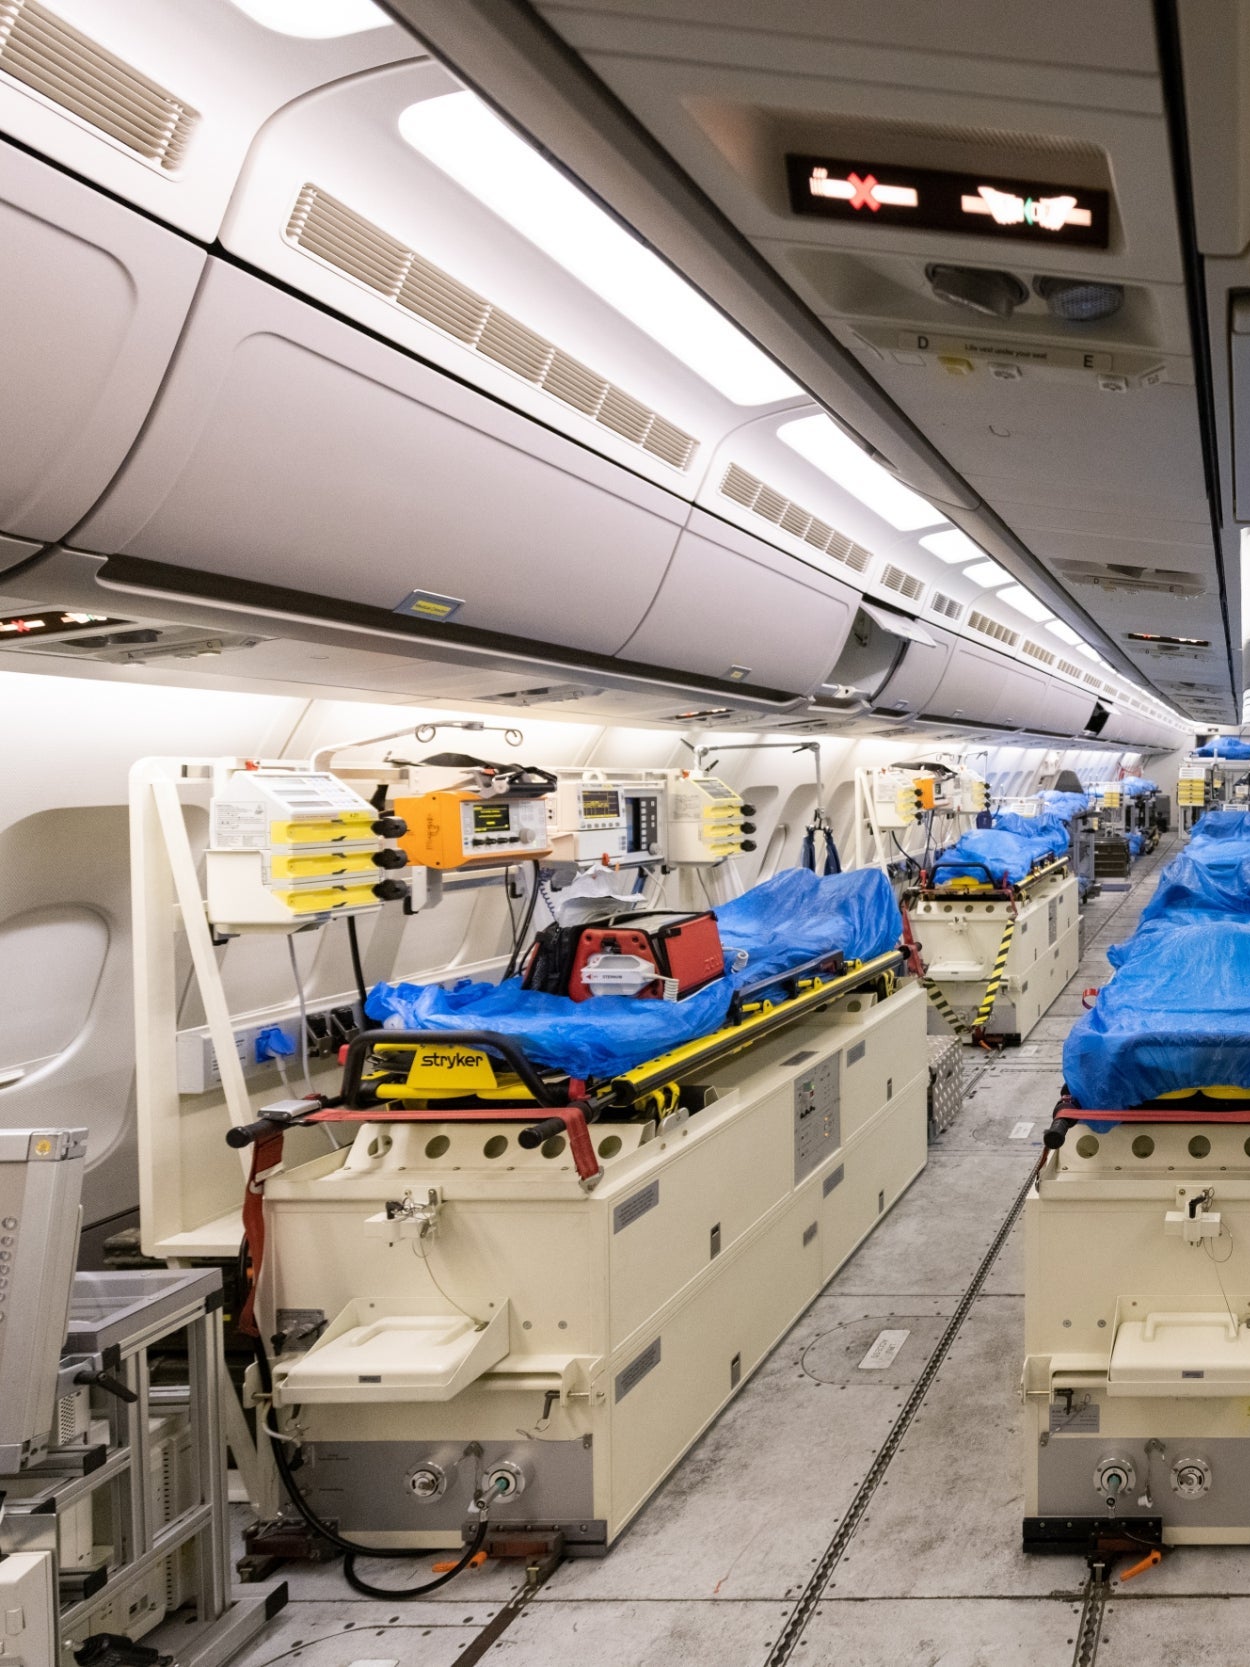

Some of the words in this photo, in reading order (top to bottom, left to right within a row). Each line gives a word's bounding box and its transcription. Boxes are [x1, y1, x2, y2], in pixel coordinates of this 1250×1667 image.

[917, 335, 929, 350] D
[1083, 354, 1094, 369] E
[420, 1052, 484, 1070] stryker
